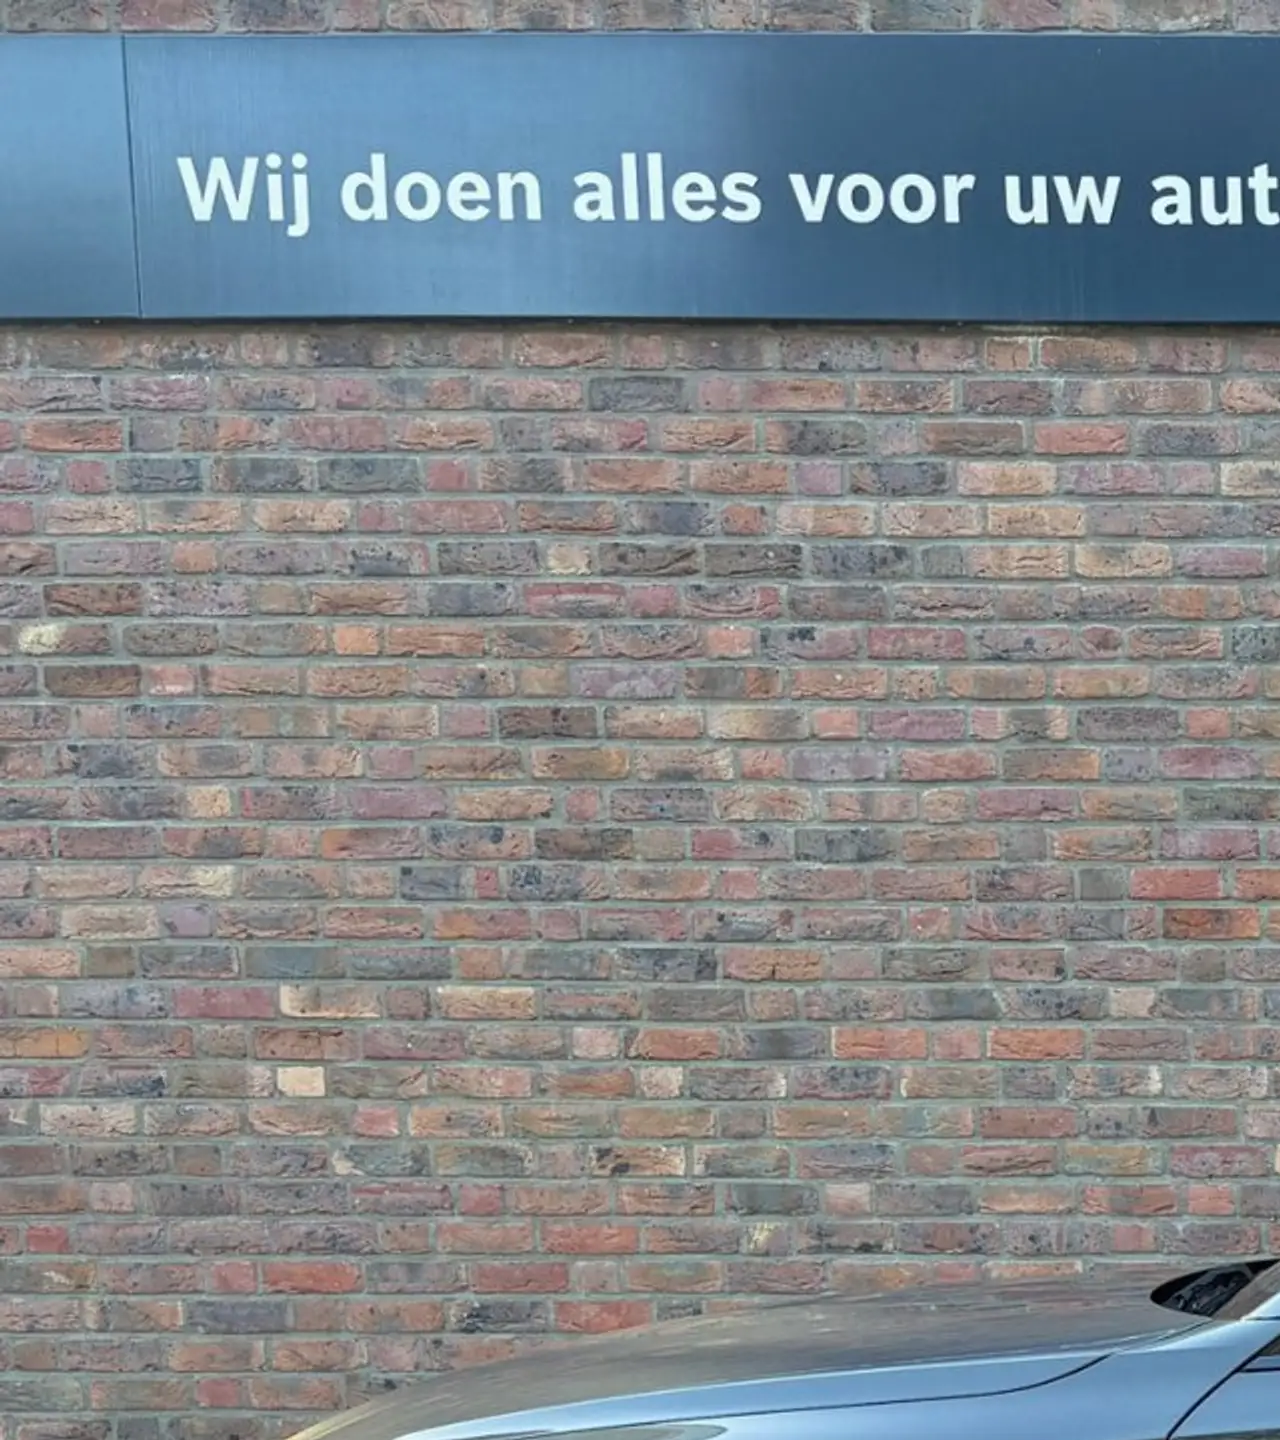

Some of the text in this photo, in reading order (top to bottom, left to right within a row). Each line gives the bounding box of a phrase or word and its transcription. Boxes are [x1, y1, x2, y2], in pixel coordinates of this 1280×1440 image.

[178, 154, 308, 236] Wij
[343, 154, 540, 220] doen
[575, 154, 760, 220] alles
[790, 175, 974, 222] voor
[1006, 177, 1119, 223] uw
